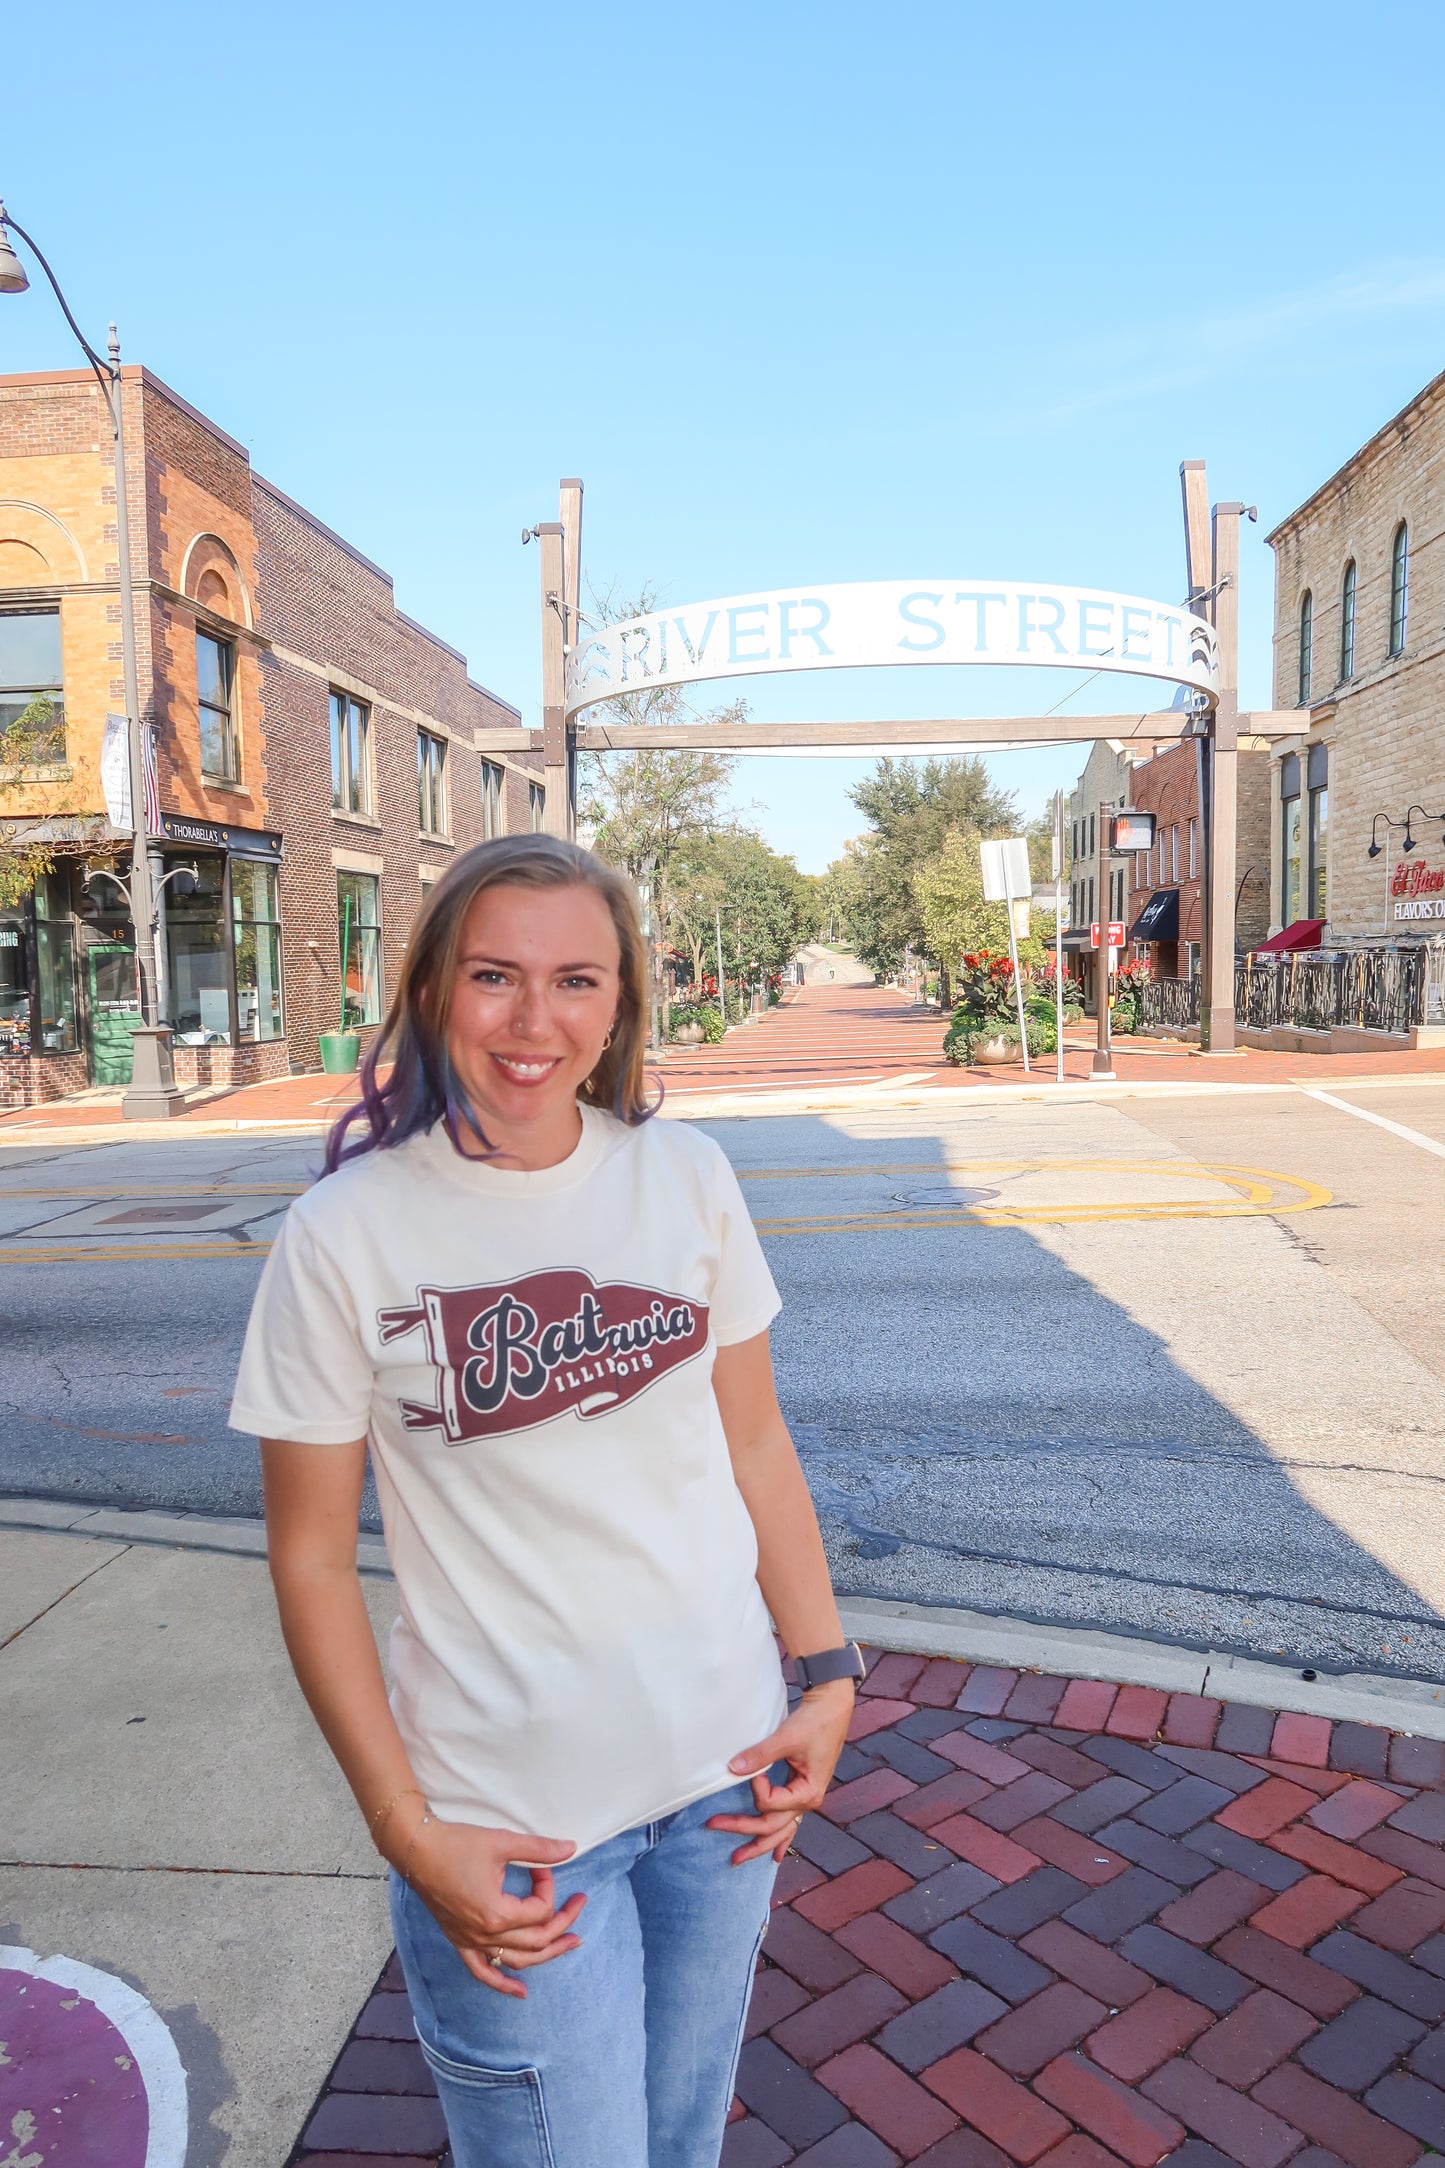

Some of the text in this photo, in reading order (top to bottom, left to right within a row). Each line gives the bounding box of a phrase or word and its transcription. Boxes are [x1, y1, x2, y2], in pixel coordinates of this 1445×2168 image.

[620, 592, 1182, 682] RIVER STREET
[173, 824, 218, 842] THORABELLA'S
[1394, 900, 1445, 920] FLAVORS O
[112, 929, 125, 940] 15
[462, 1293, 695, 1413] Batavia
